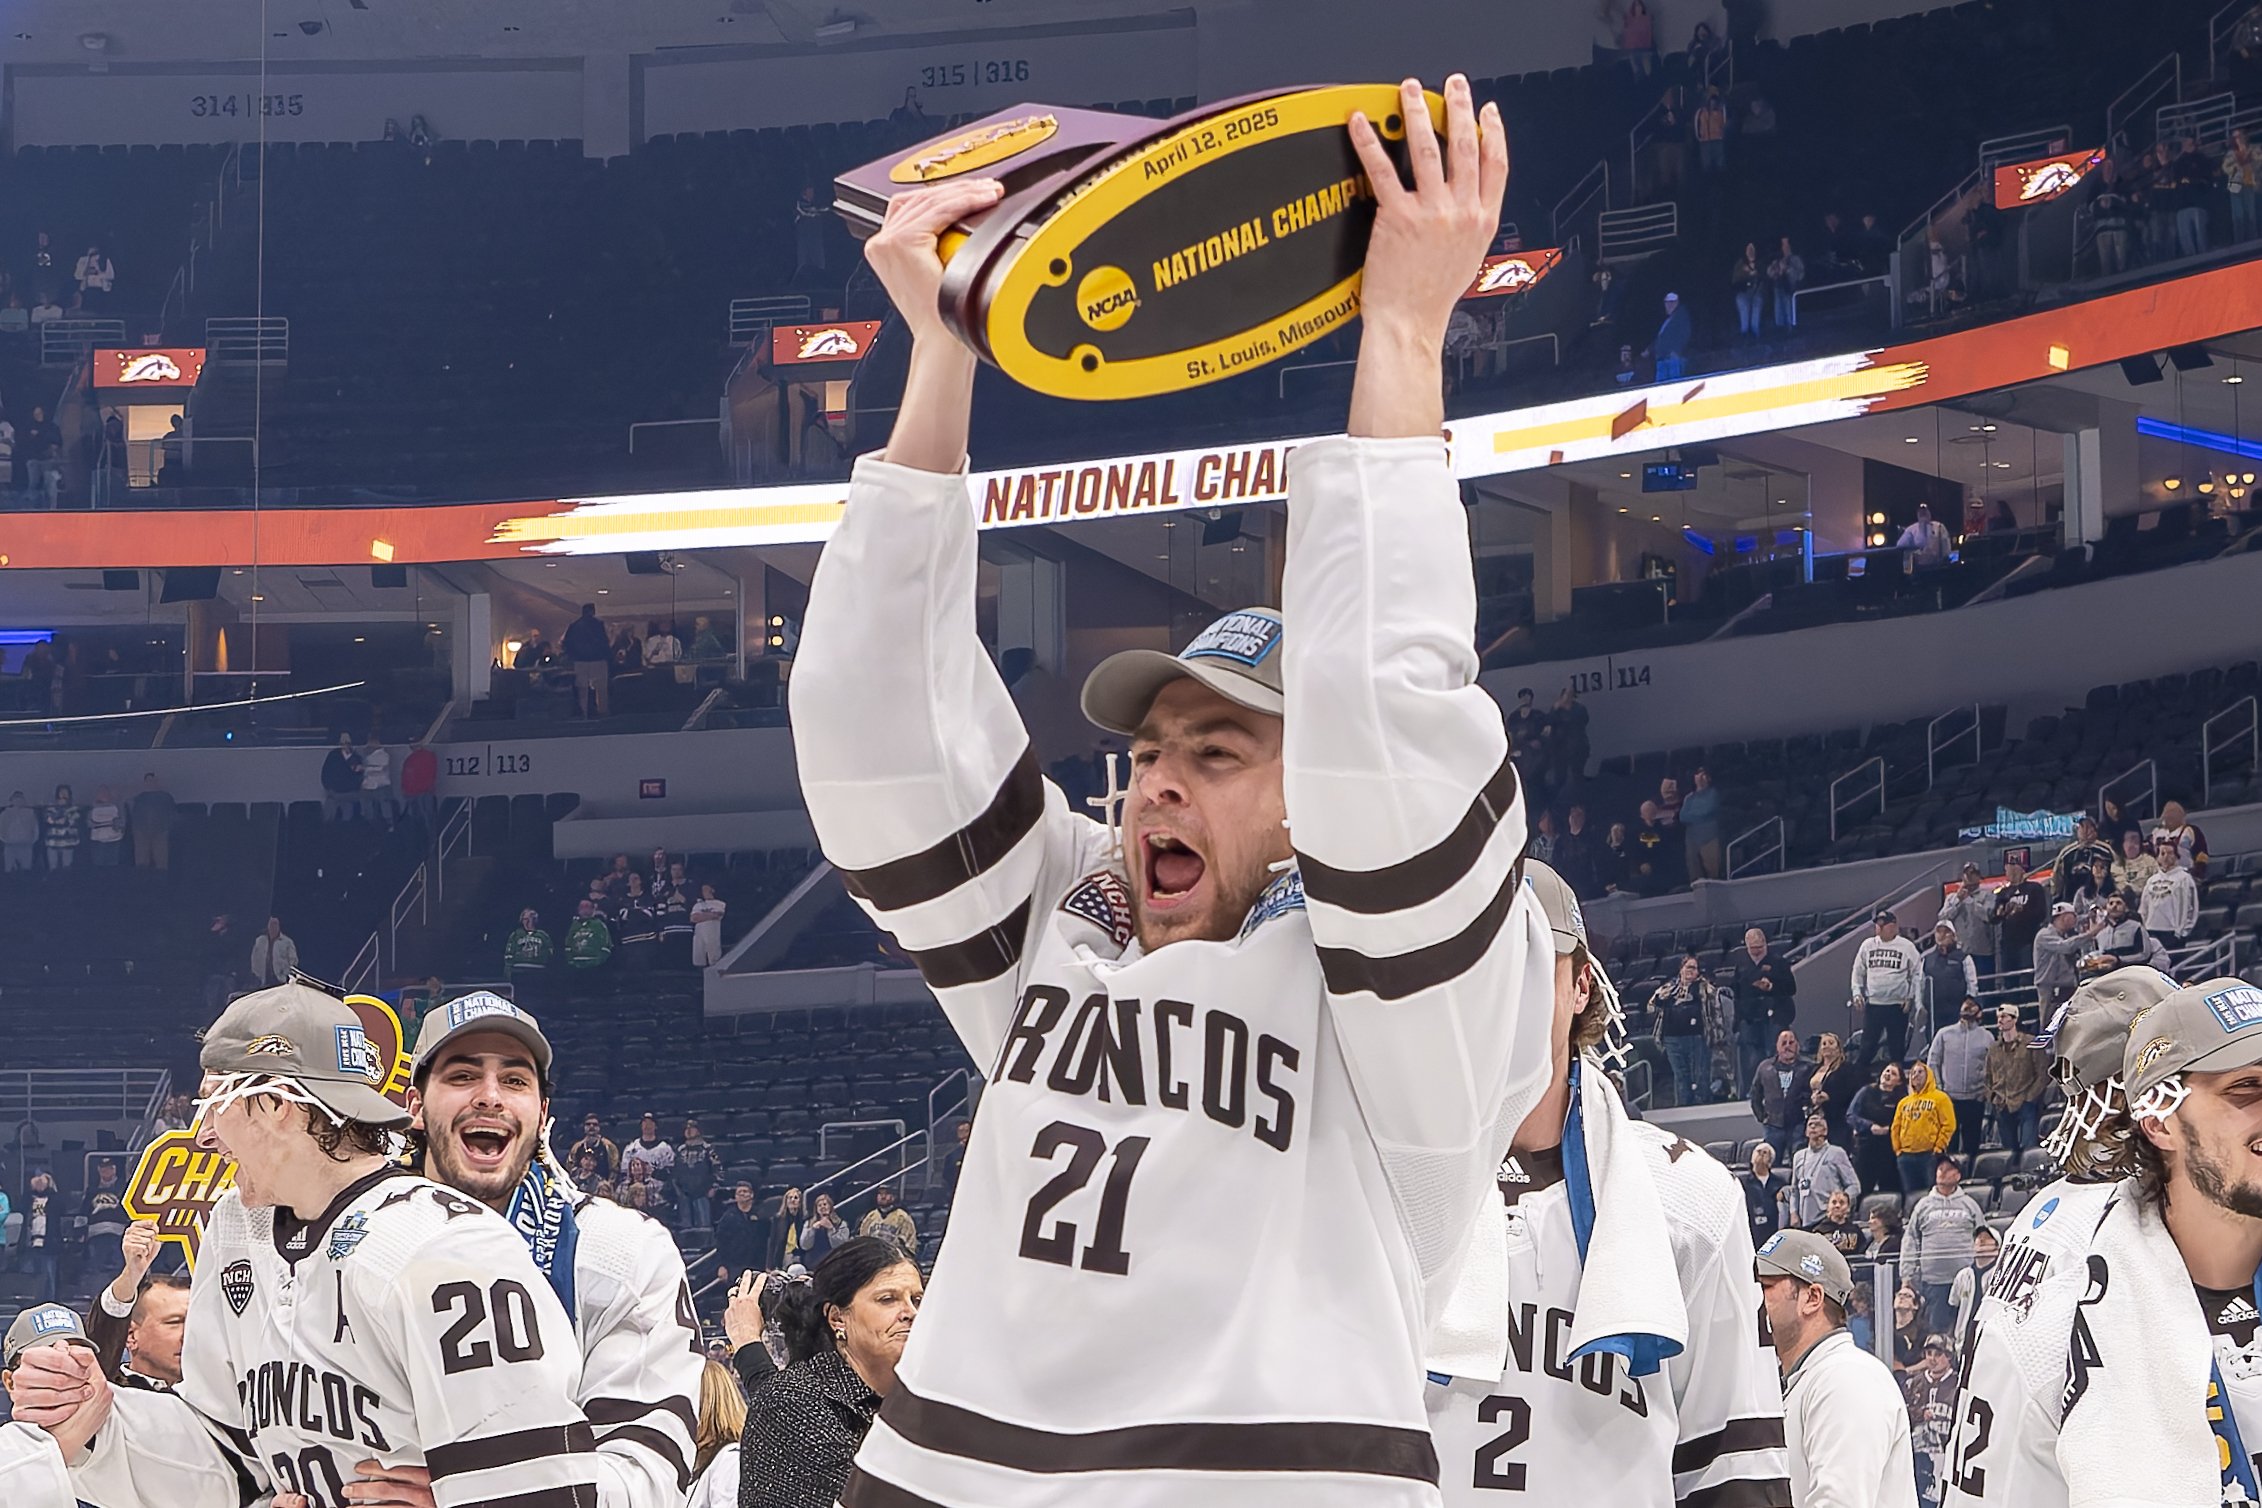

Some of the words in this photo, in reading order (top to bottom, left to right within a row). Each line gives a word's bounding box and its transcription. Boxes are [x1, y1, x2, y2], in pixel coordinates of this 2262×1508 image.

[191, 95, 238, 117] 314
[921, 65, 965, 88] 315
[985, 60, 1029, 83] 316
[1143, 157, 1188, 180] April
[1191, 132, 1223, 155] 12,
[1224, 108, 1280, 141] 2025
[1152, 216, 1269, 293] NATIONAL
[1087, 287, 1137, 321] NCAA
[1186, 359, 1216, 380] St.
[1219, 341, 1278, 371] Louis,
[982, 457, 1179, 524] NATIONAL
[1617, 665, 1650, 689] 114
[446, 757, 480, 776] 112
[497, 754, 531, 774] 113
[1092, 872, 1131, 946] NCHC
[992, 984, 1300, 1153] RONCOS
[1018, 1120, 1151, 1276] 21
[222, 1268, 253, 1287] NCH
[430, 1278, 546, 1376] 20
[237, 1360, 392, 1452] RONCOS
[1472, 1394, 1532, 1492] 2
